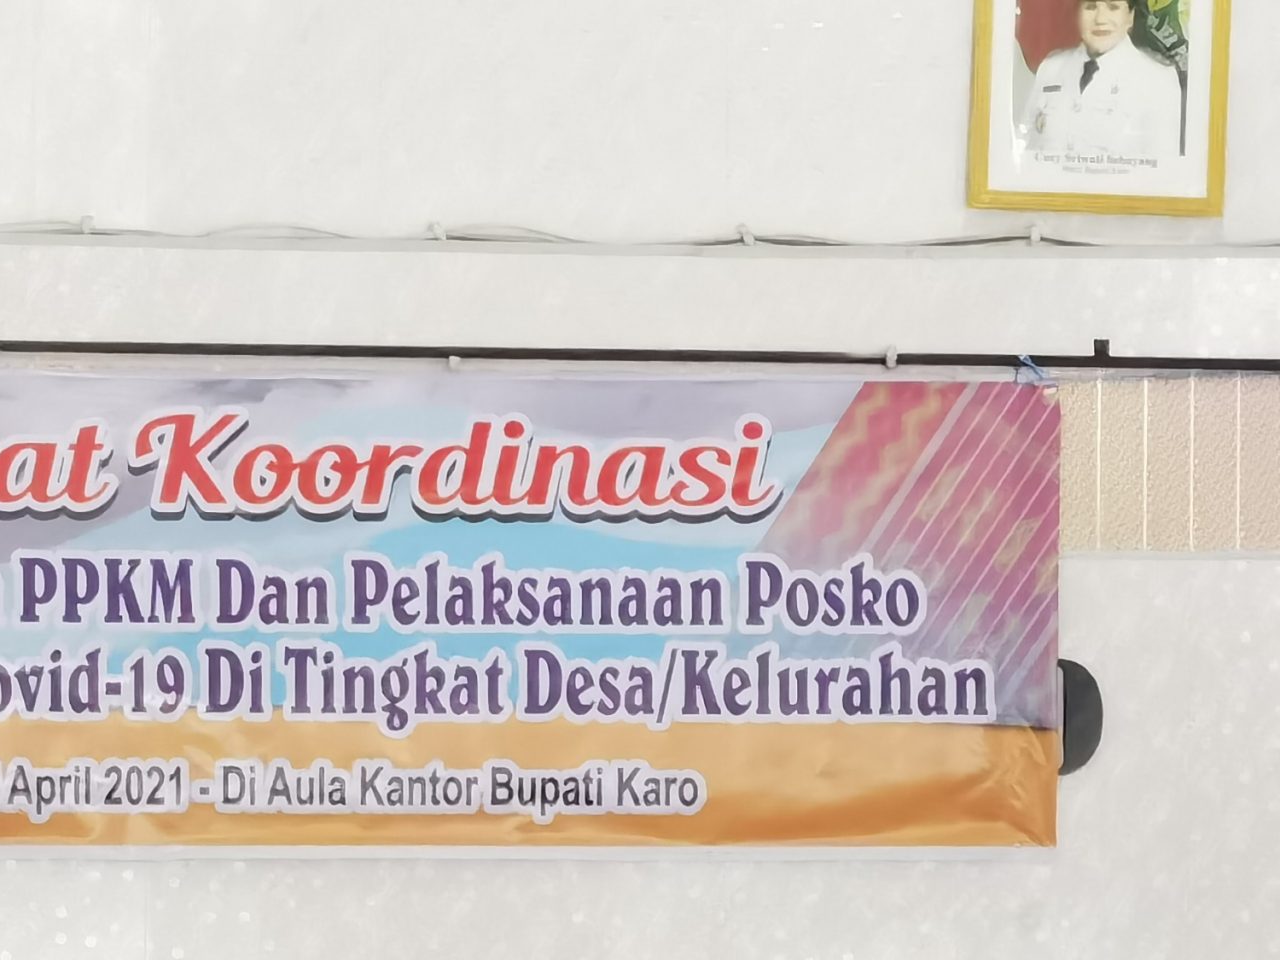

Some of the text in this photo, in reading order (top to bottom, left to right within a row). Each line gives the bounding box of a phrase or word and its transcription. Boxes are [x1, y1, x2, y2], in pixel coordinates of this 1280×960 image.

[133, 412, 776, 507] Koordinasi
[19, 556, 196, 625] PPKM
[215, 558, 330, 626] Dan
[351, 558, 724, 628] Pelaksanaan
[745, 560, 920, 628] Posko
[204, 646, 264, 715] Di
[283, 645, 505, 732] Tingkat
[523, 647, 989, 724] Desa/Kelurahan
[7, 764, 91, 815] April
[103, 764, 183, 807] 2021
[221, 765, 257, 806] Di
[266, 765, 347, 807] Aula
[359, 765, 479, 807] Kantor
[490, 765, 604, 817] Bupati
[617, 766, 700, 808] Karo
